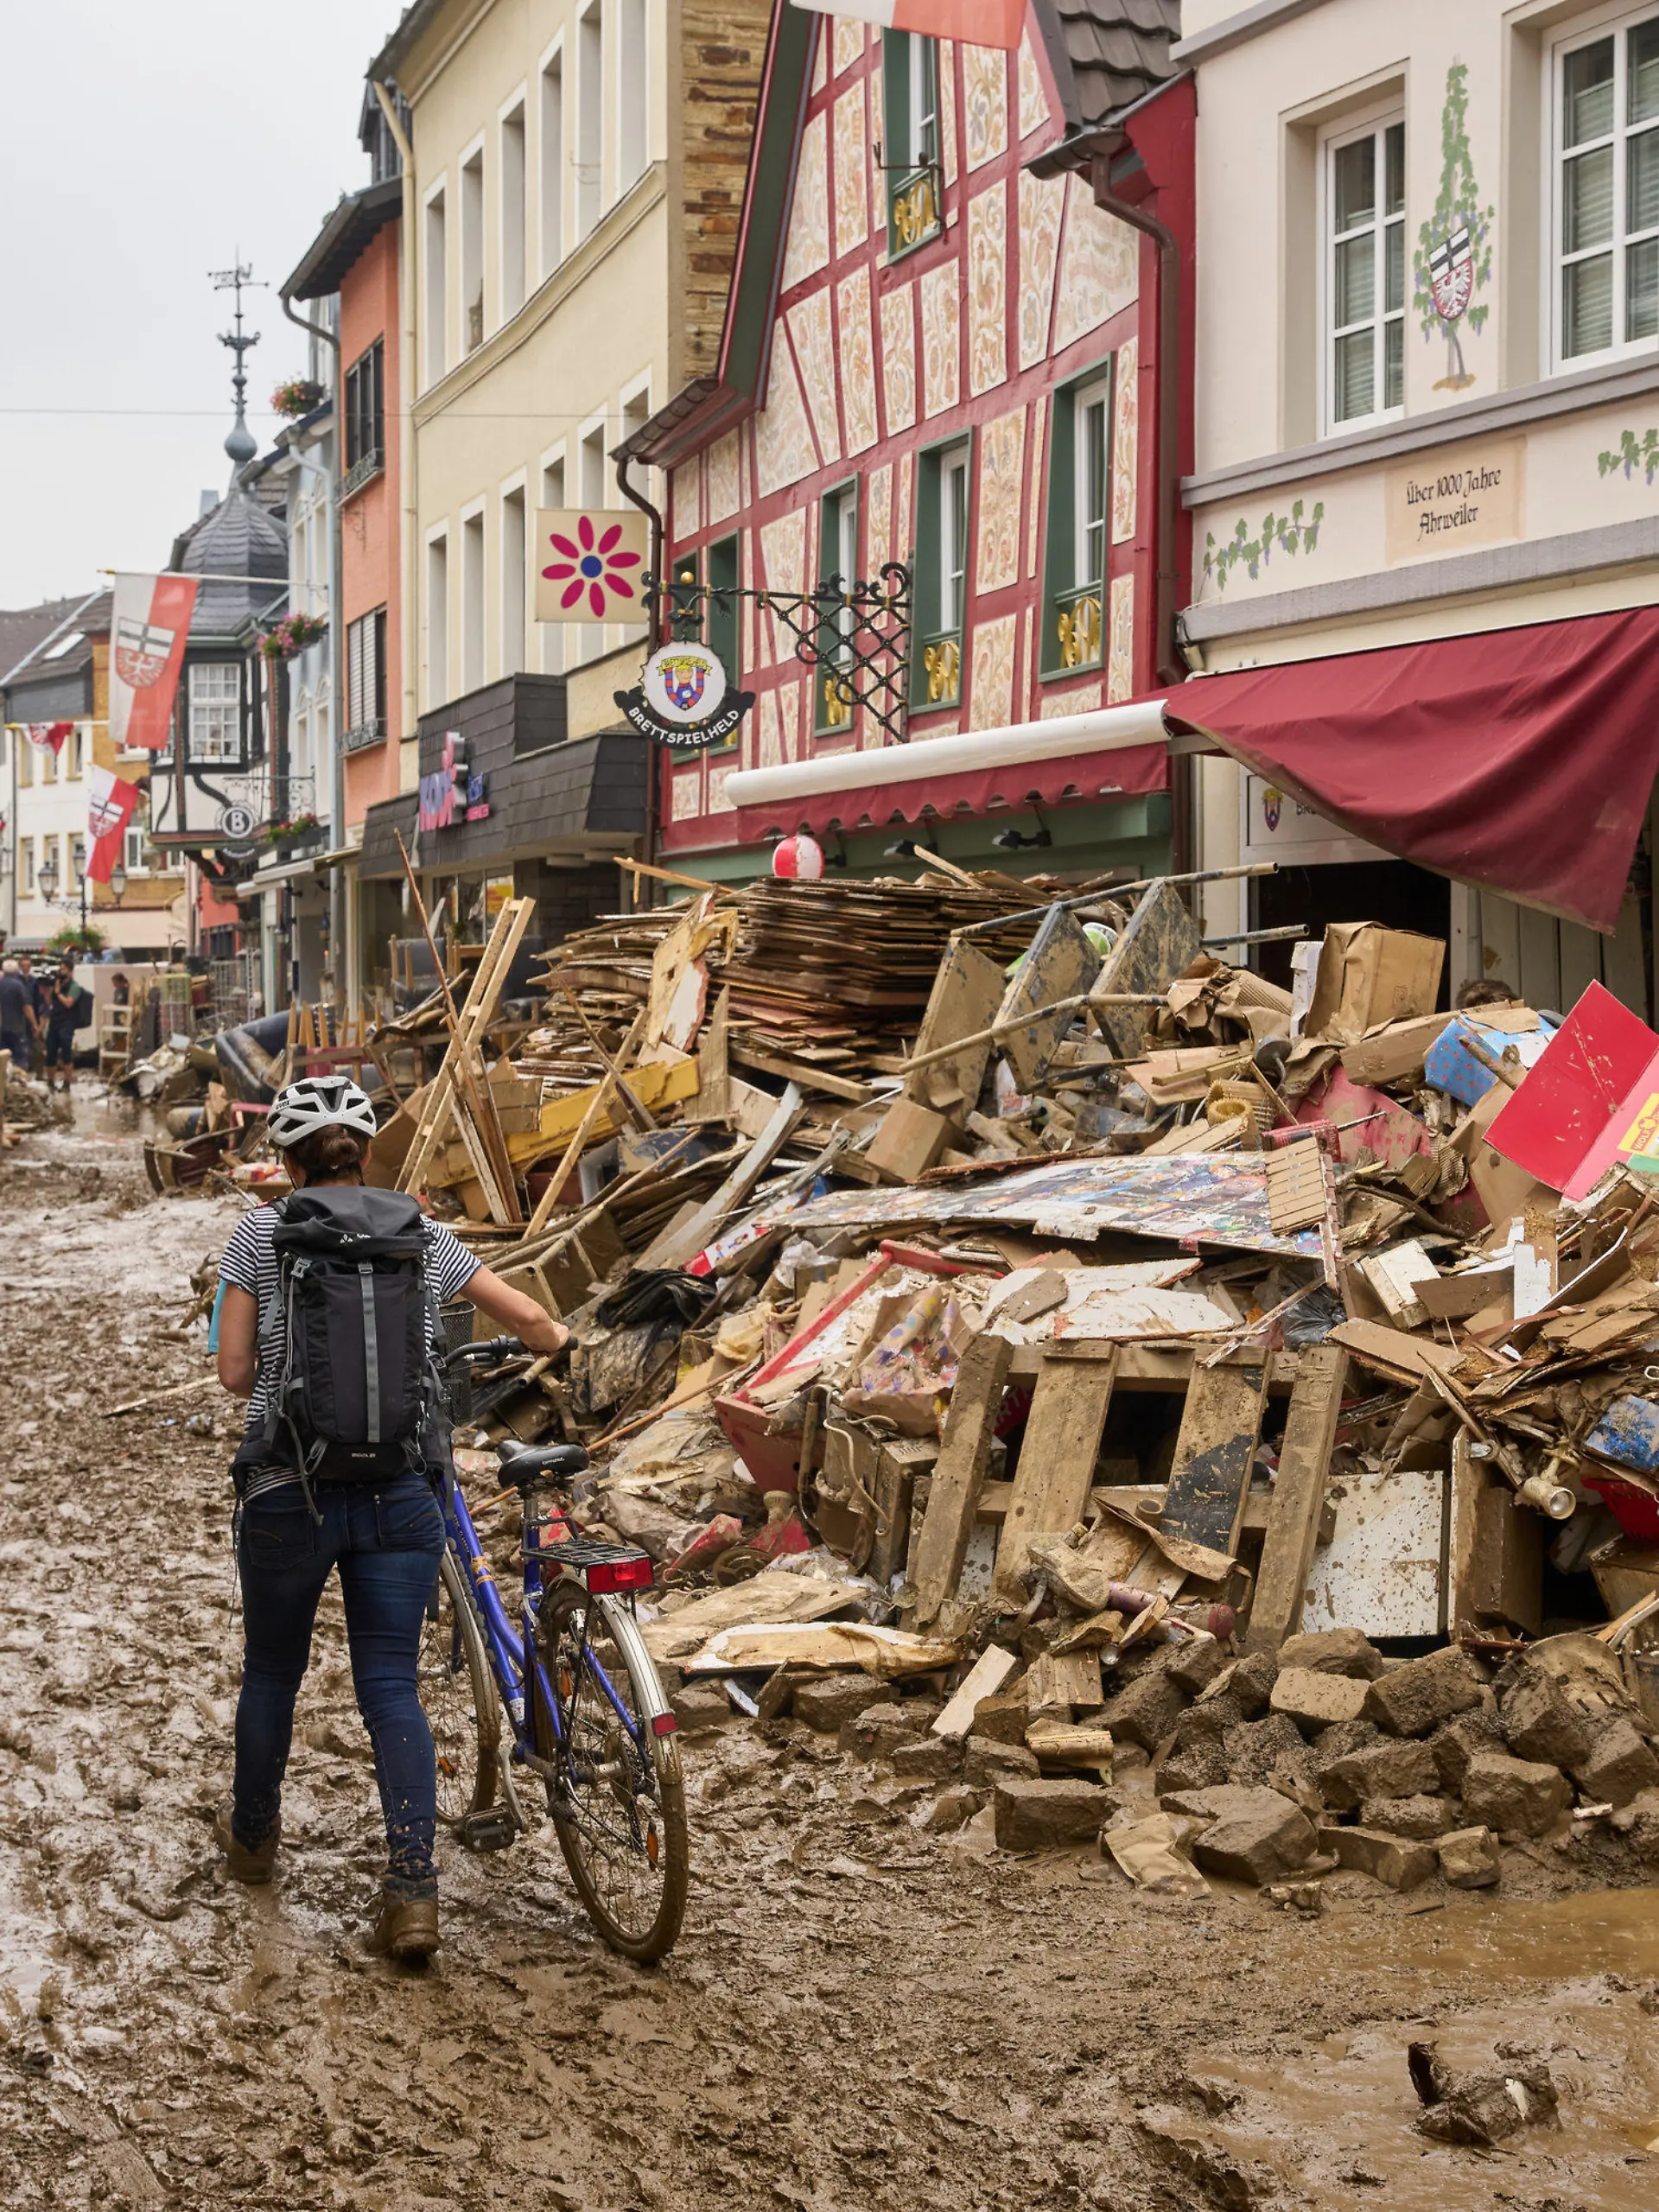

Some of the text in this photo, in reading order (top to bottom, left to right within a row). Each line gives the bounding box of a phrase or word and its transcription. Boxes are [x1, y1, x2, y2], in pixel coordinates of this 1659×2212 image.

[1406, 466, 1502, 505] Über 1000 Jahre
[1417, 502, 1478, 542] Ahrweiler
[628, 706, 740, 745] BRETTSPIELHELD
[231, 810, 245, 833] B
